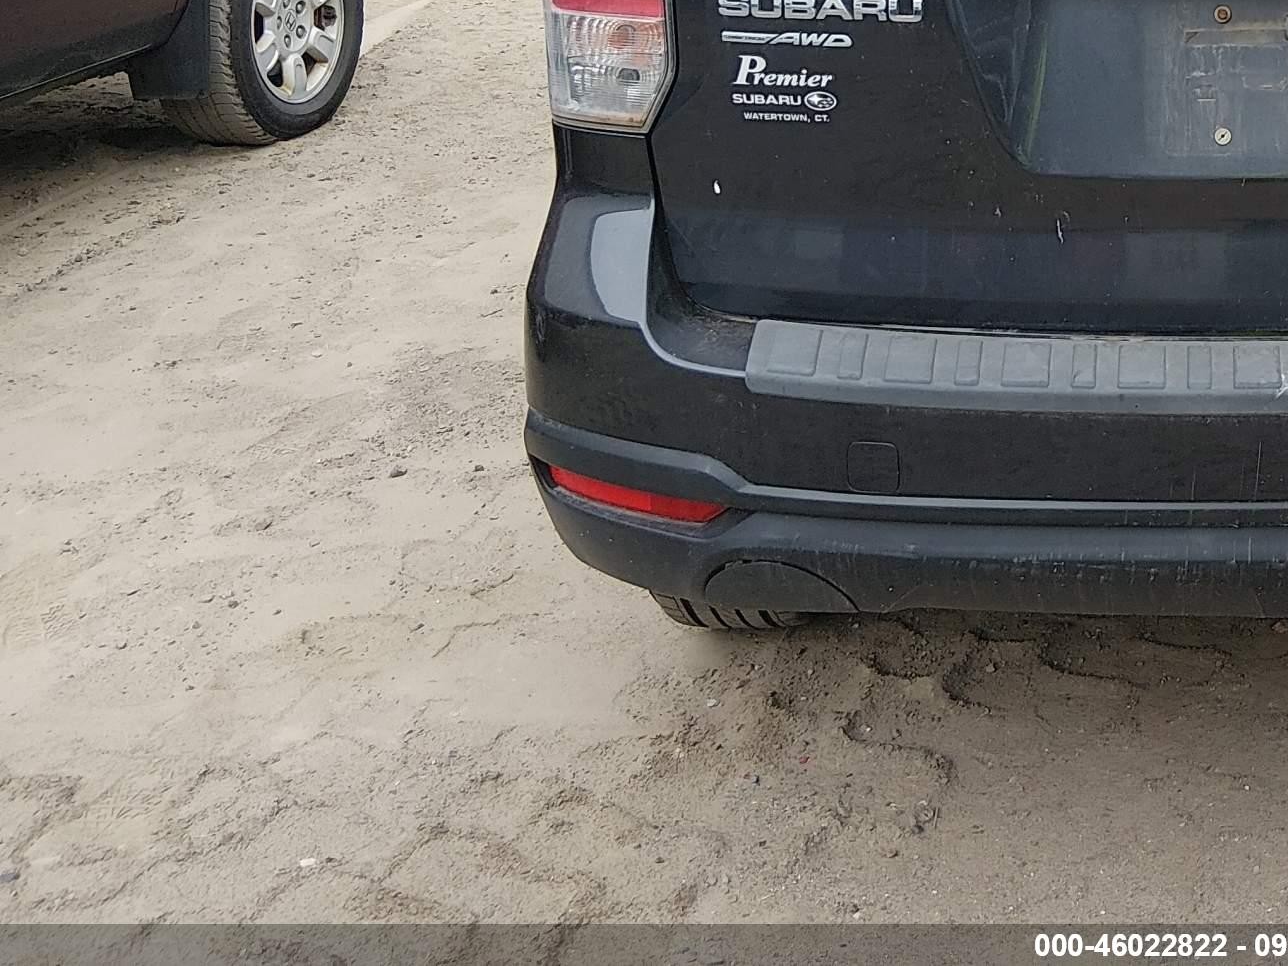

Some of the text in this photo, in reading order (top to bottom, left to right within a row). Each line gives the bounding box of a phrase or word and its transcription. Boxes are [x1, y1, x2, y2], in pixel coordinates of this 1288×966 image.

[769, 31, 854, 48] AWD
[732, 55, 834, 88] Premier
[732, 93, 802, 106] SUBARU
[743, 112, 831, 124] WATERTOWN, CT.
